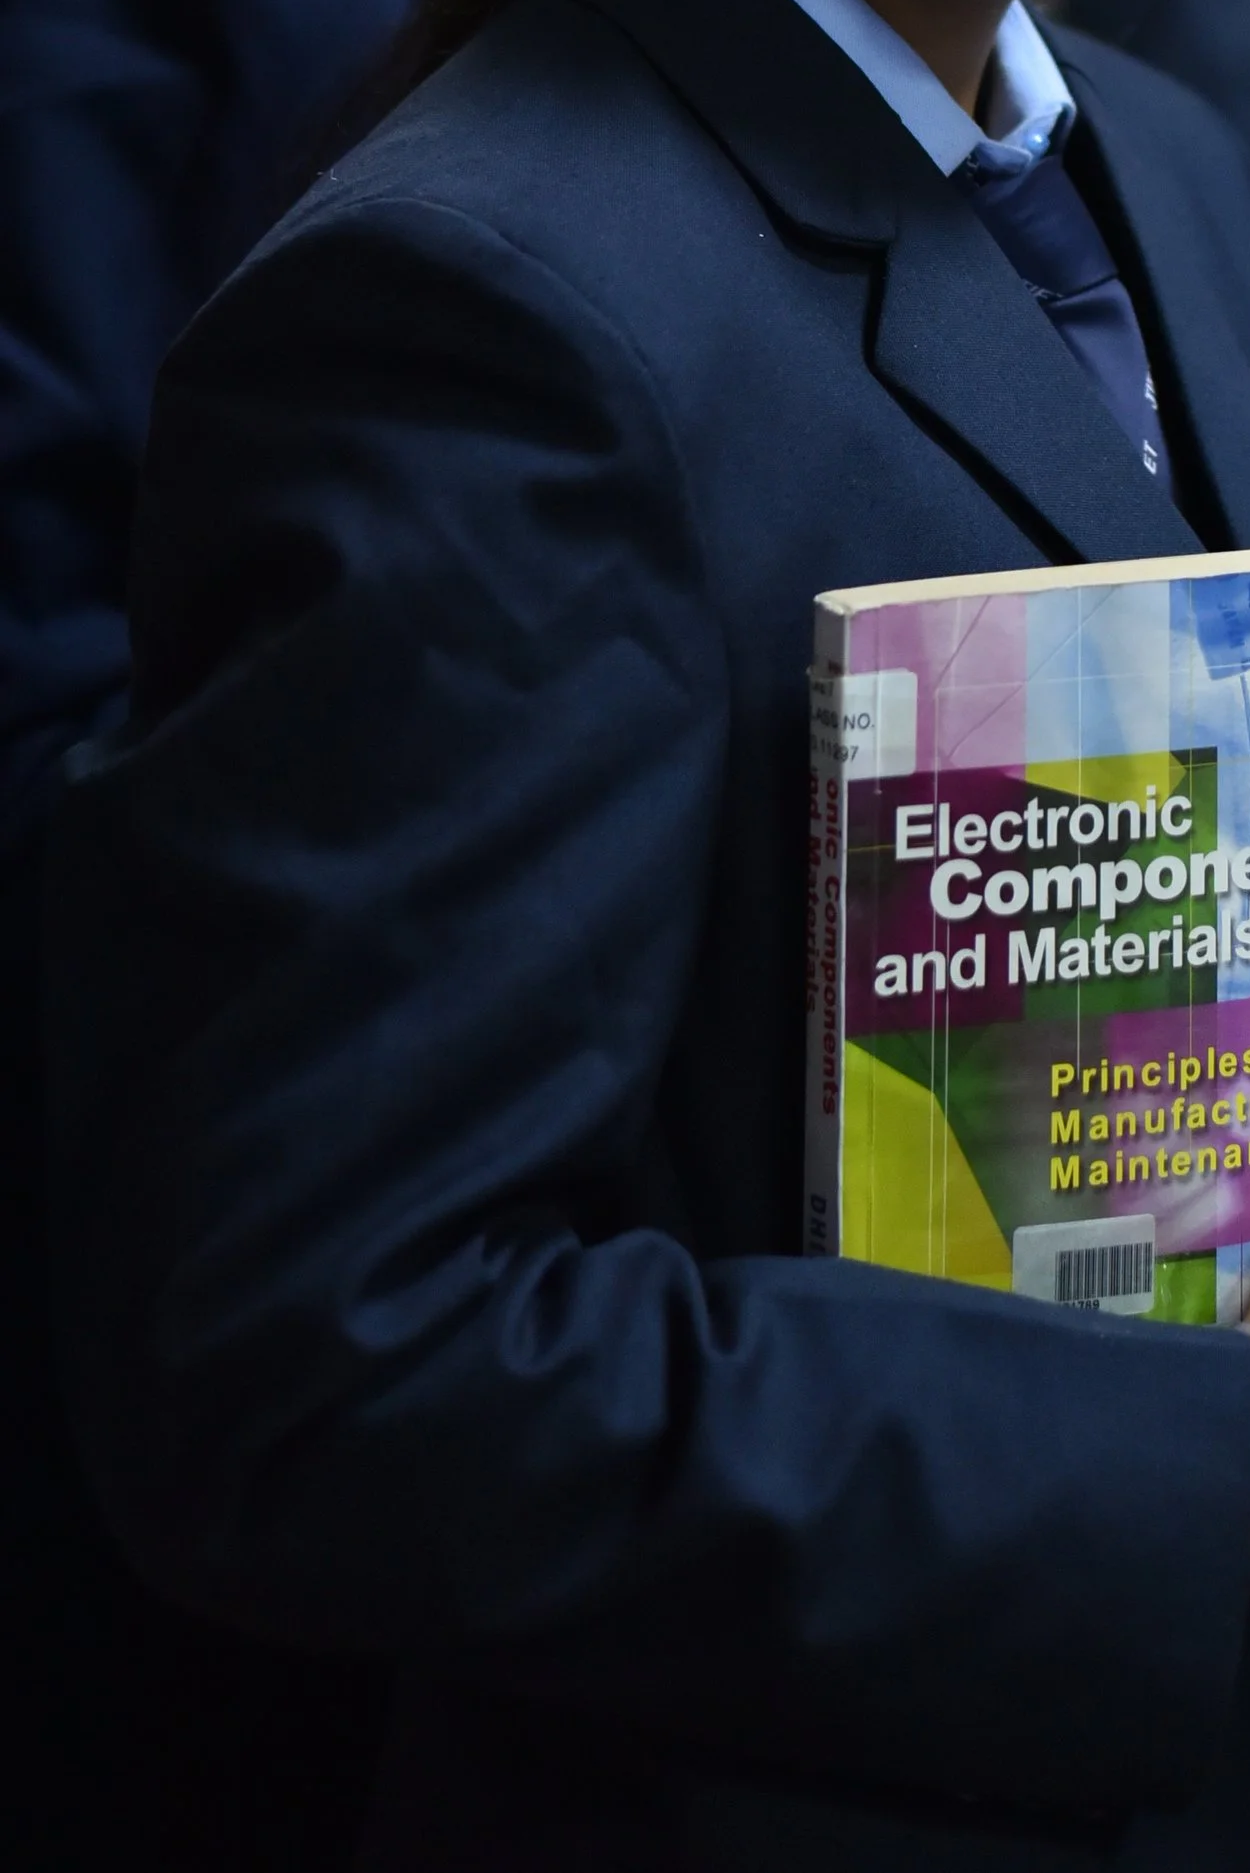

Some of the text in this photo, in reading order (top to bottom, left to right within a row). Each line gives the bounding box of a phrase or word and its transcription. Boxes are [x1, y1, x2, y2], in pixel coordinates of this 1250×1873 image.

[843, 713, 875, 730] NO.
[894, 786, 1193, 862] Electronic
[821, 875, 841, 1115] Components
[874, 935, 986, 996] and
